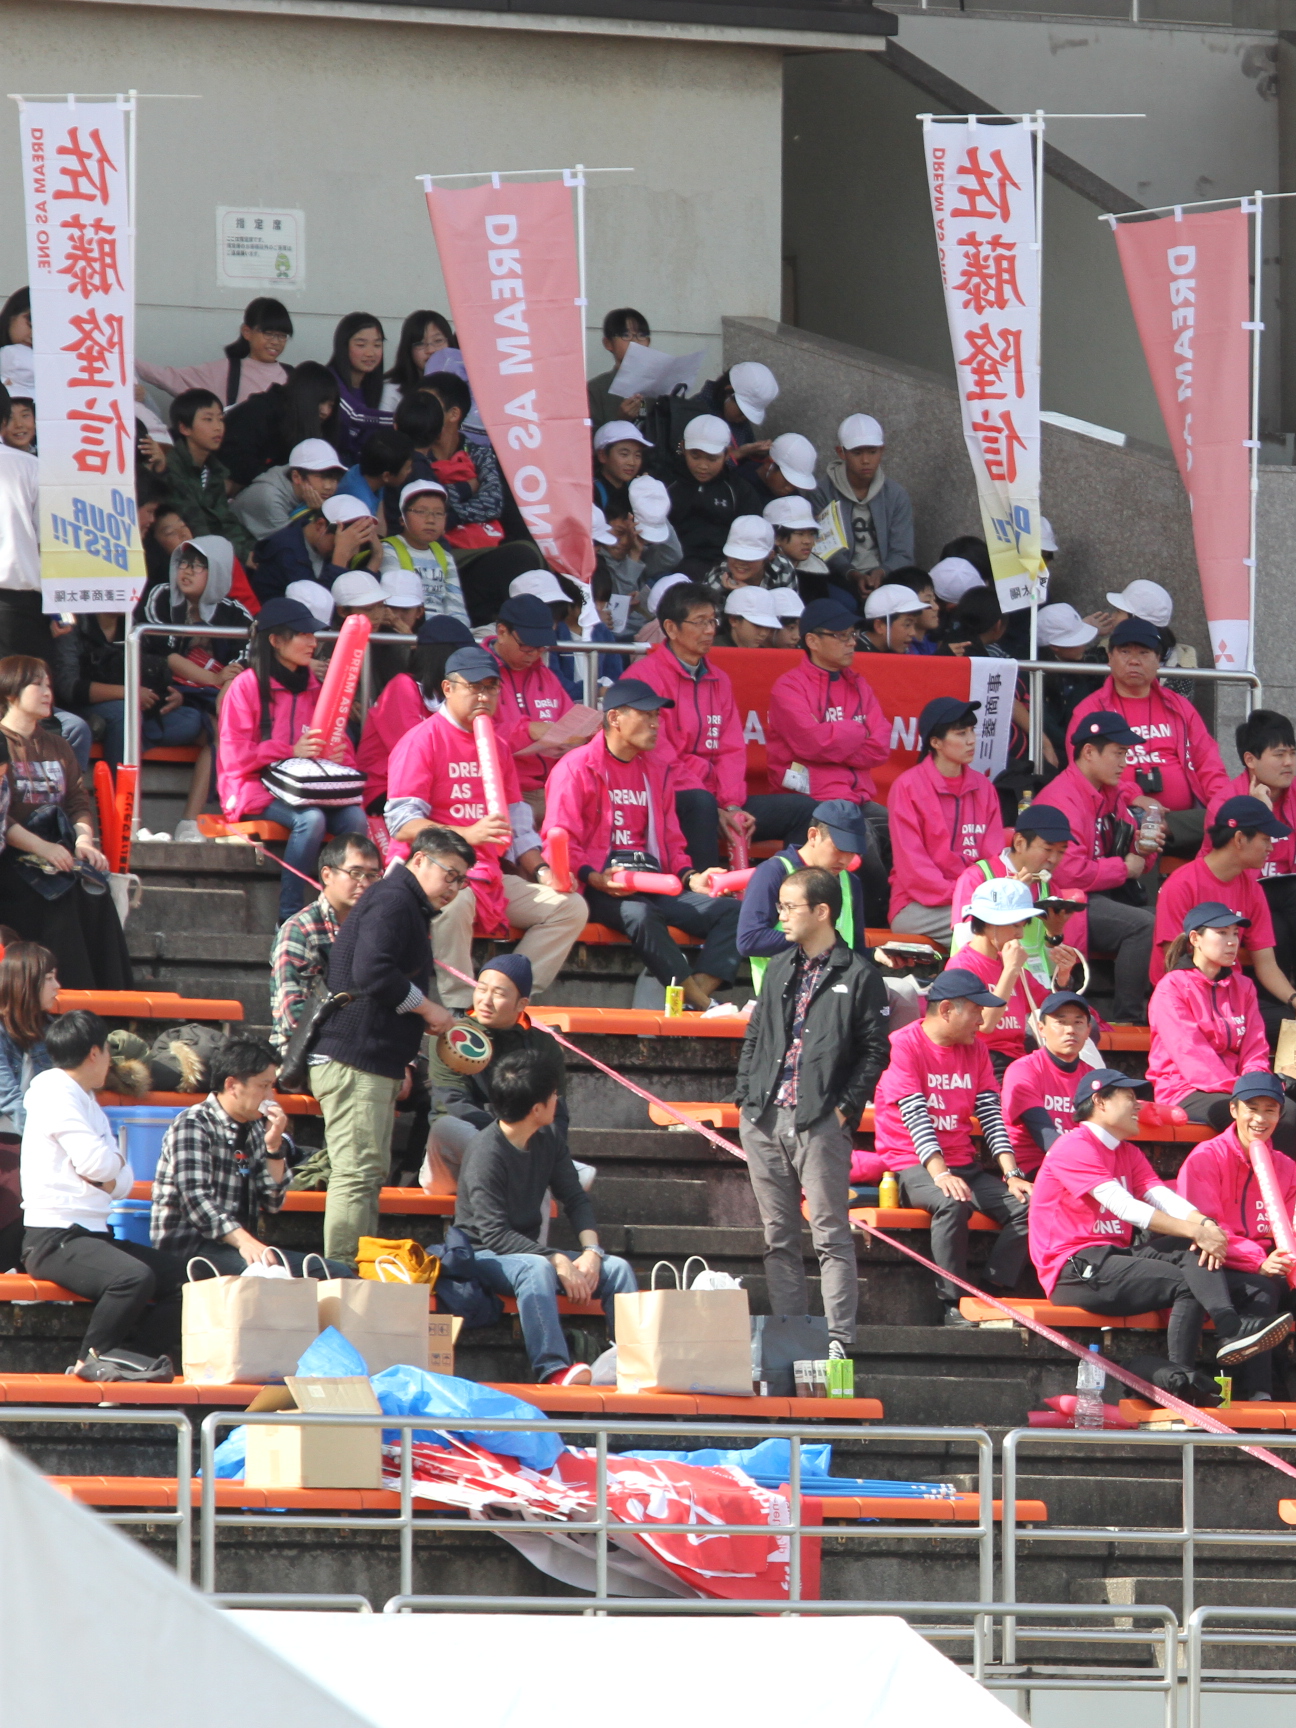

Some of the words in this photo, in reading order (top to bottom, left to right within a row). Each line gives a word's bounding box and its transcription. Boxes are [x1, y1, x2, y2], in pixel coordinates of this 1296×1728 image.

[343, 648, 364, 692] DREAM
[338, 695, 351, 714] AS
[451, 783, 472, 799] AS
